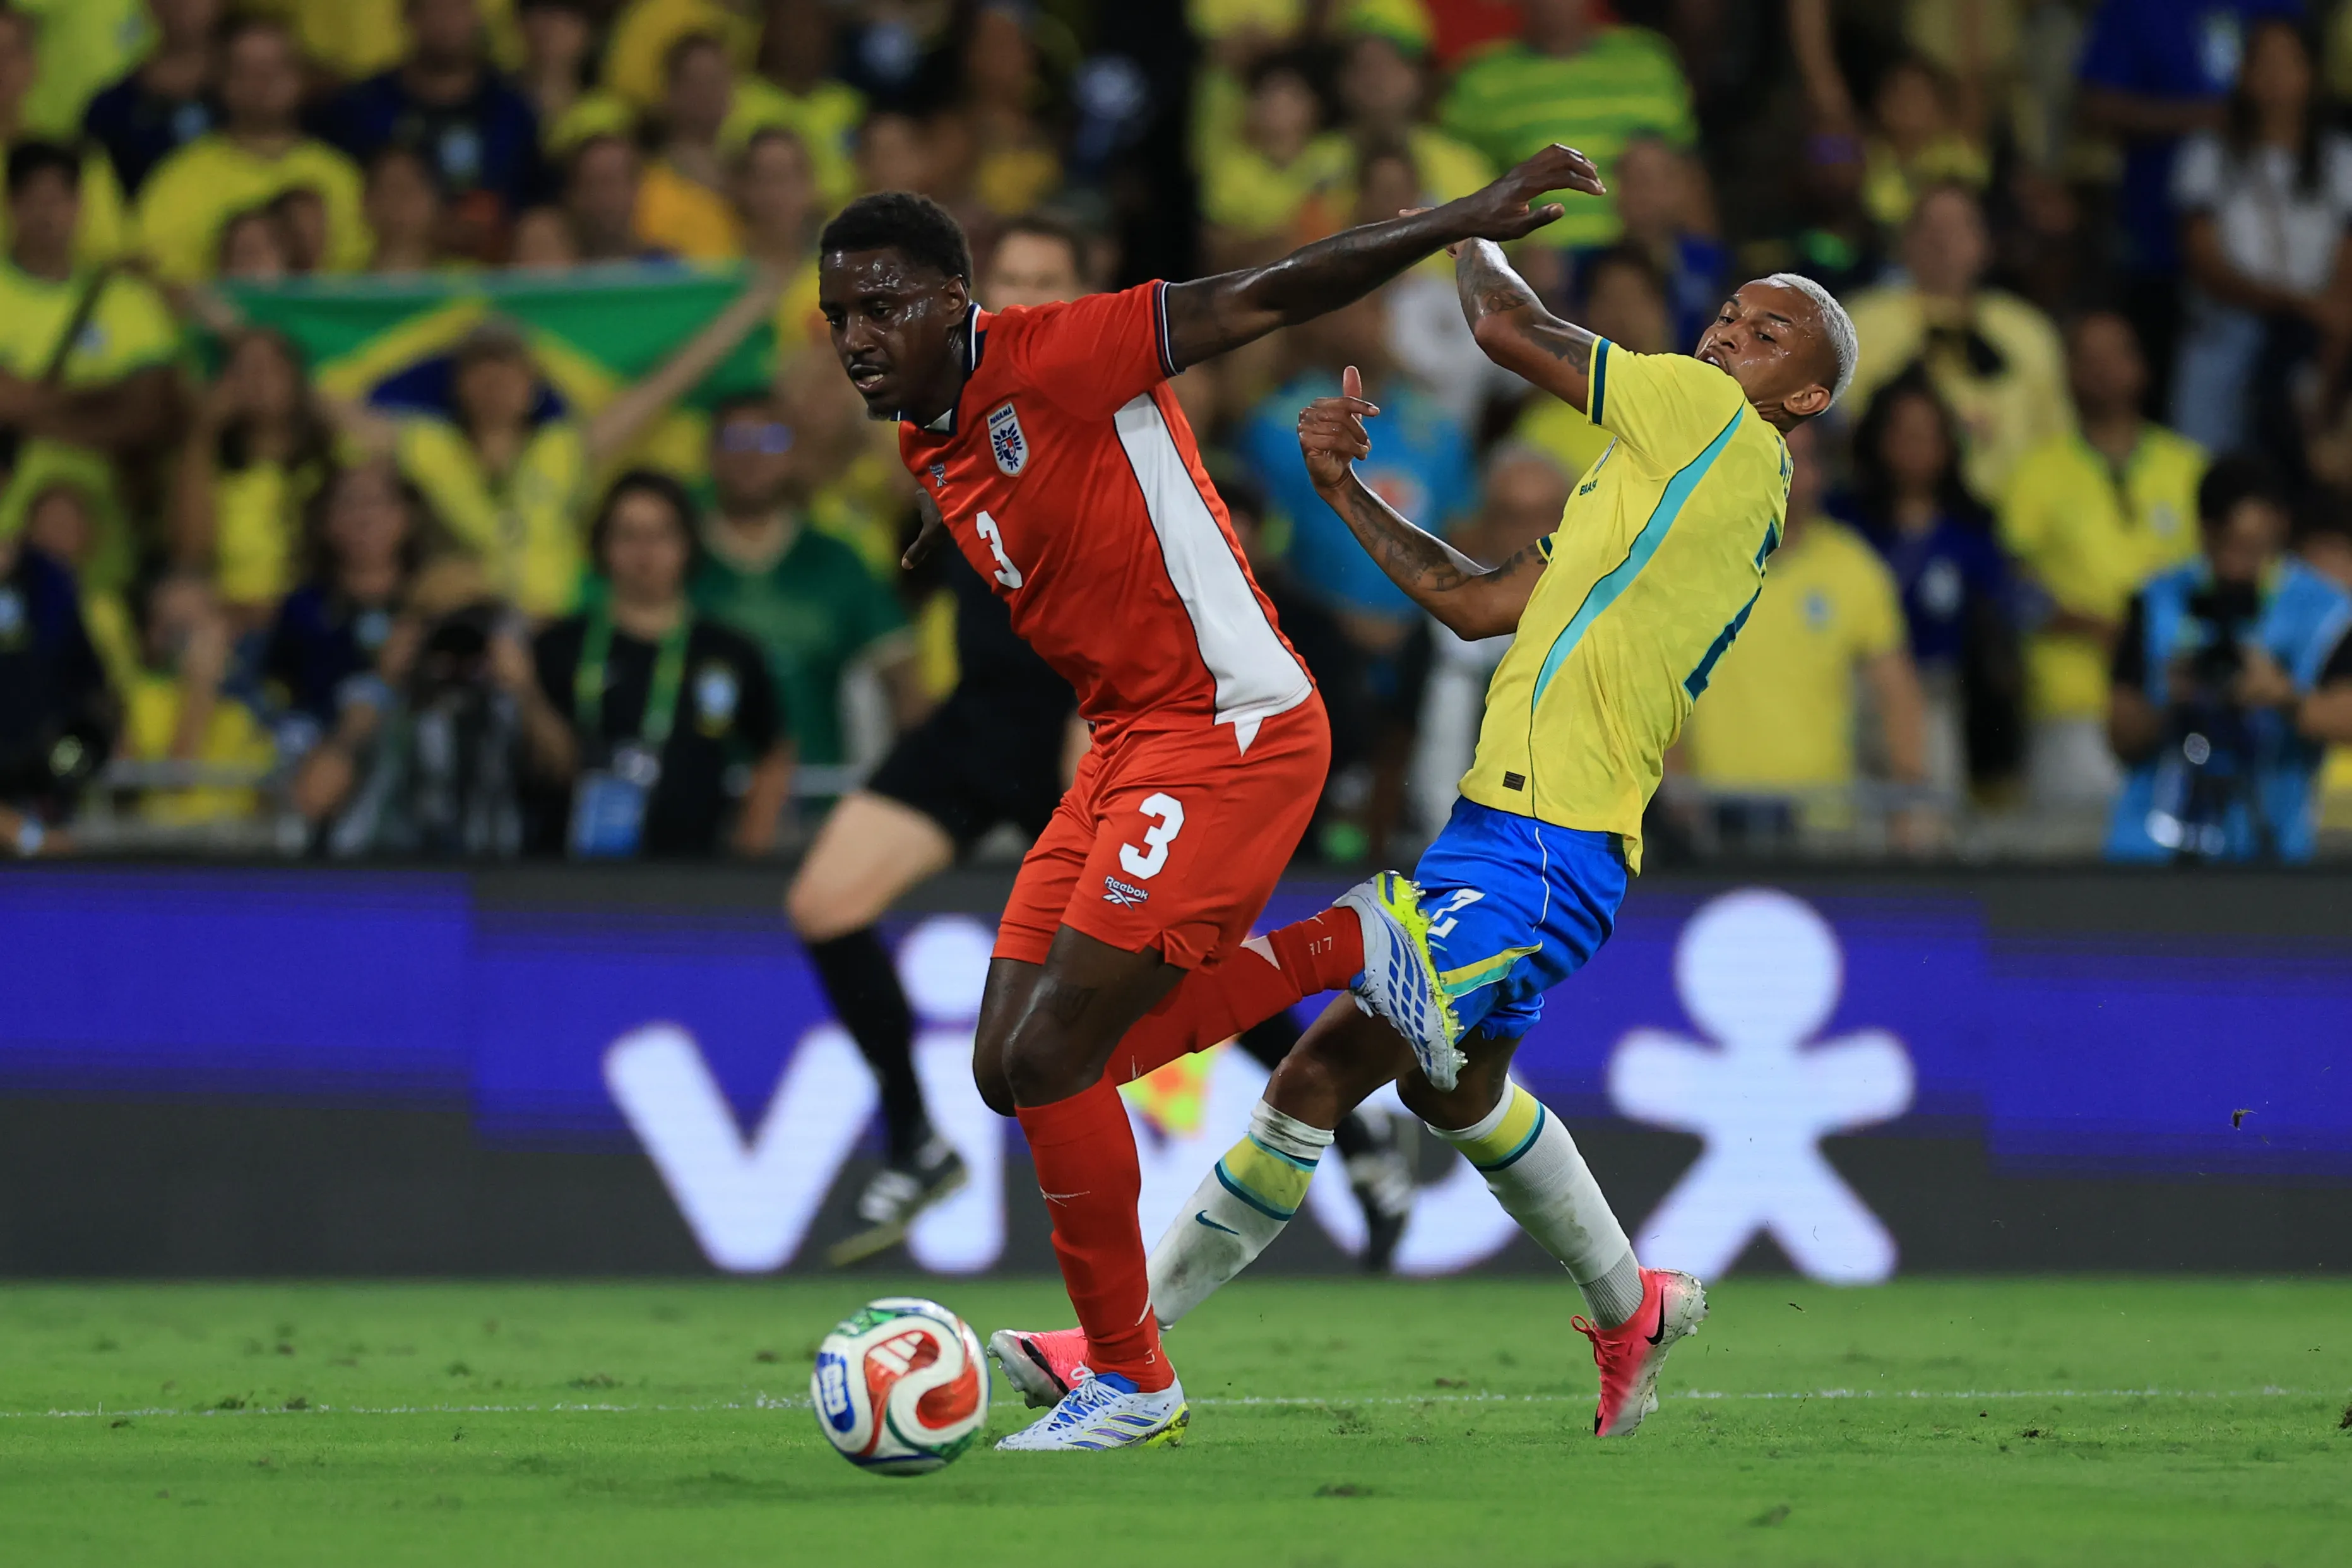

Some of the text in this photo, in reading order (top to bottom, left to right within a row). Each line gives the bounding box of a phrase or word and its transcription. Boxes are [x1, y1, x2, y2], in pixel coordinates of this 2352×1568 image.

[976, 510, 1023, 589] 3
[1119, 792, 1185, 881] 3
[1105, 876, 1149, 900] Reebok
